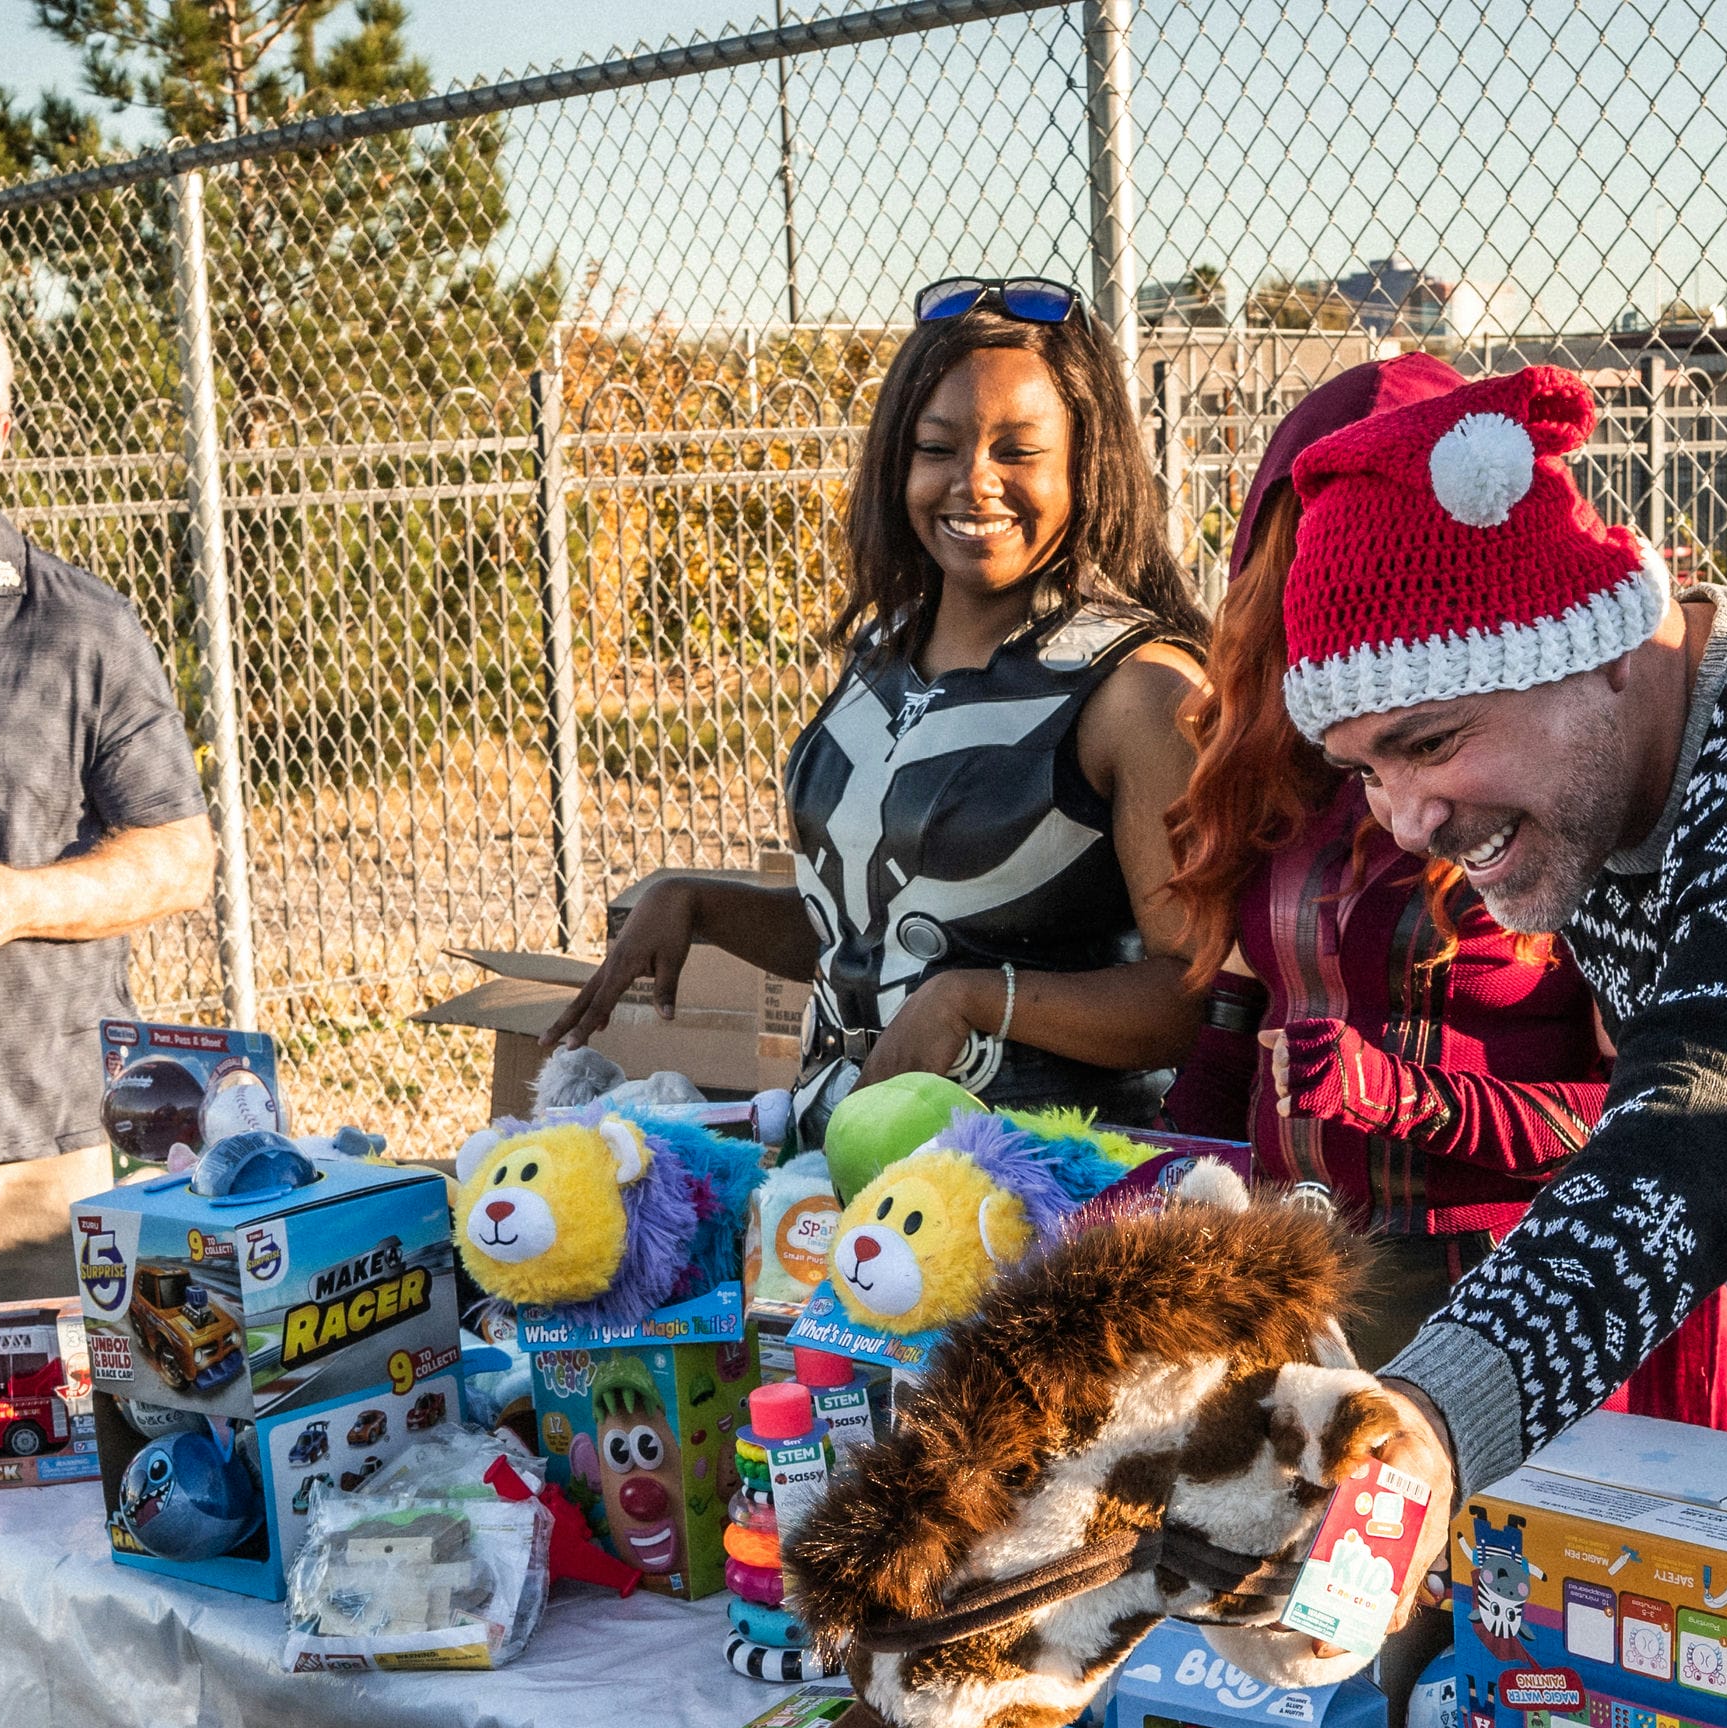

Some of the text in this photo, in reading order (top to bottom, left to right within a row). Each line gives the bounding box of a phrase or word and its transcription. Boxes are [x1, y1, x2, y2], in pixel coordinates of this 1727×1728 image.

[187, 1229, 204, 1261] 9
[207, 1236, 216, 1245] TO
[205, 1245, 233, 1255] COLLECT!
[246, 1248, 282, 1271] SURPRISE
[80, 1263, 127, 1280] SURPRISE
[315, 1250, 385, 1300] MAKE
[283, 1269, 426, 1362] RACER
[602, 1318, 688, 1343] your Magic
[92, 1336, 129, 1353] UNBOX
[797, 1318, 925, 1363] What's in your Magic
[95, 1354, 132, 1368] & BUILD
[415, 1349, 457, 1378] COLLECT!
[419, 1352, 432, 1363] TO
[96, 1370, 133, 1378] A RACE CAR!
[388, 1350, 414, 1395] 9
[824, 1393, 860, 1408] STEM
[835, 1414, 869, 1428] sassy
[777, 1448, 815, 1463] STEM
[788, 1470, 824, 1484] sassy
[1564, 1548, 1608, 1566] MAGIC PEN
[1653, 1568, 1694, 1588] SAFETY
[1568, 1584, 1612, 1598] disappeared
[1569, 1590, 1599, 1604] minutes
[1631, 1599, 1662, 1612] minutes
[1687, 1615, 1720, 1632] Painting
[1516, 1673, 1566, 1688] PAINTING
[1507, 1689, 1580, 1705] MAGIC WATER
